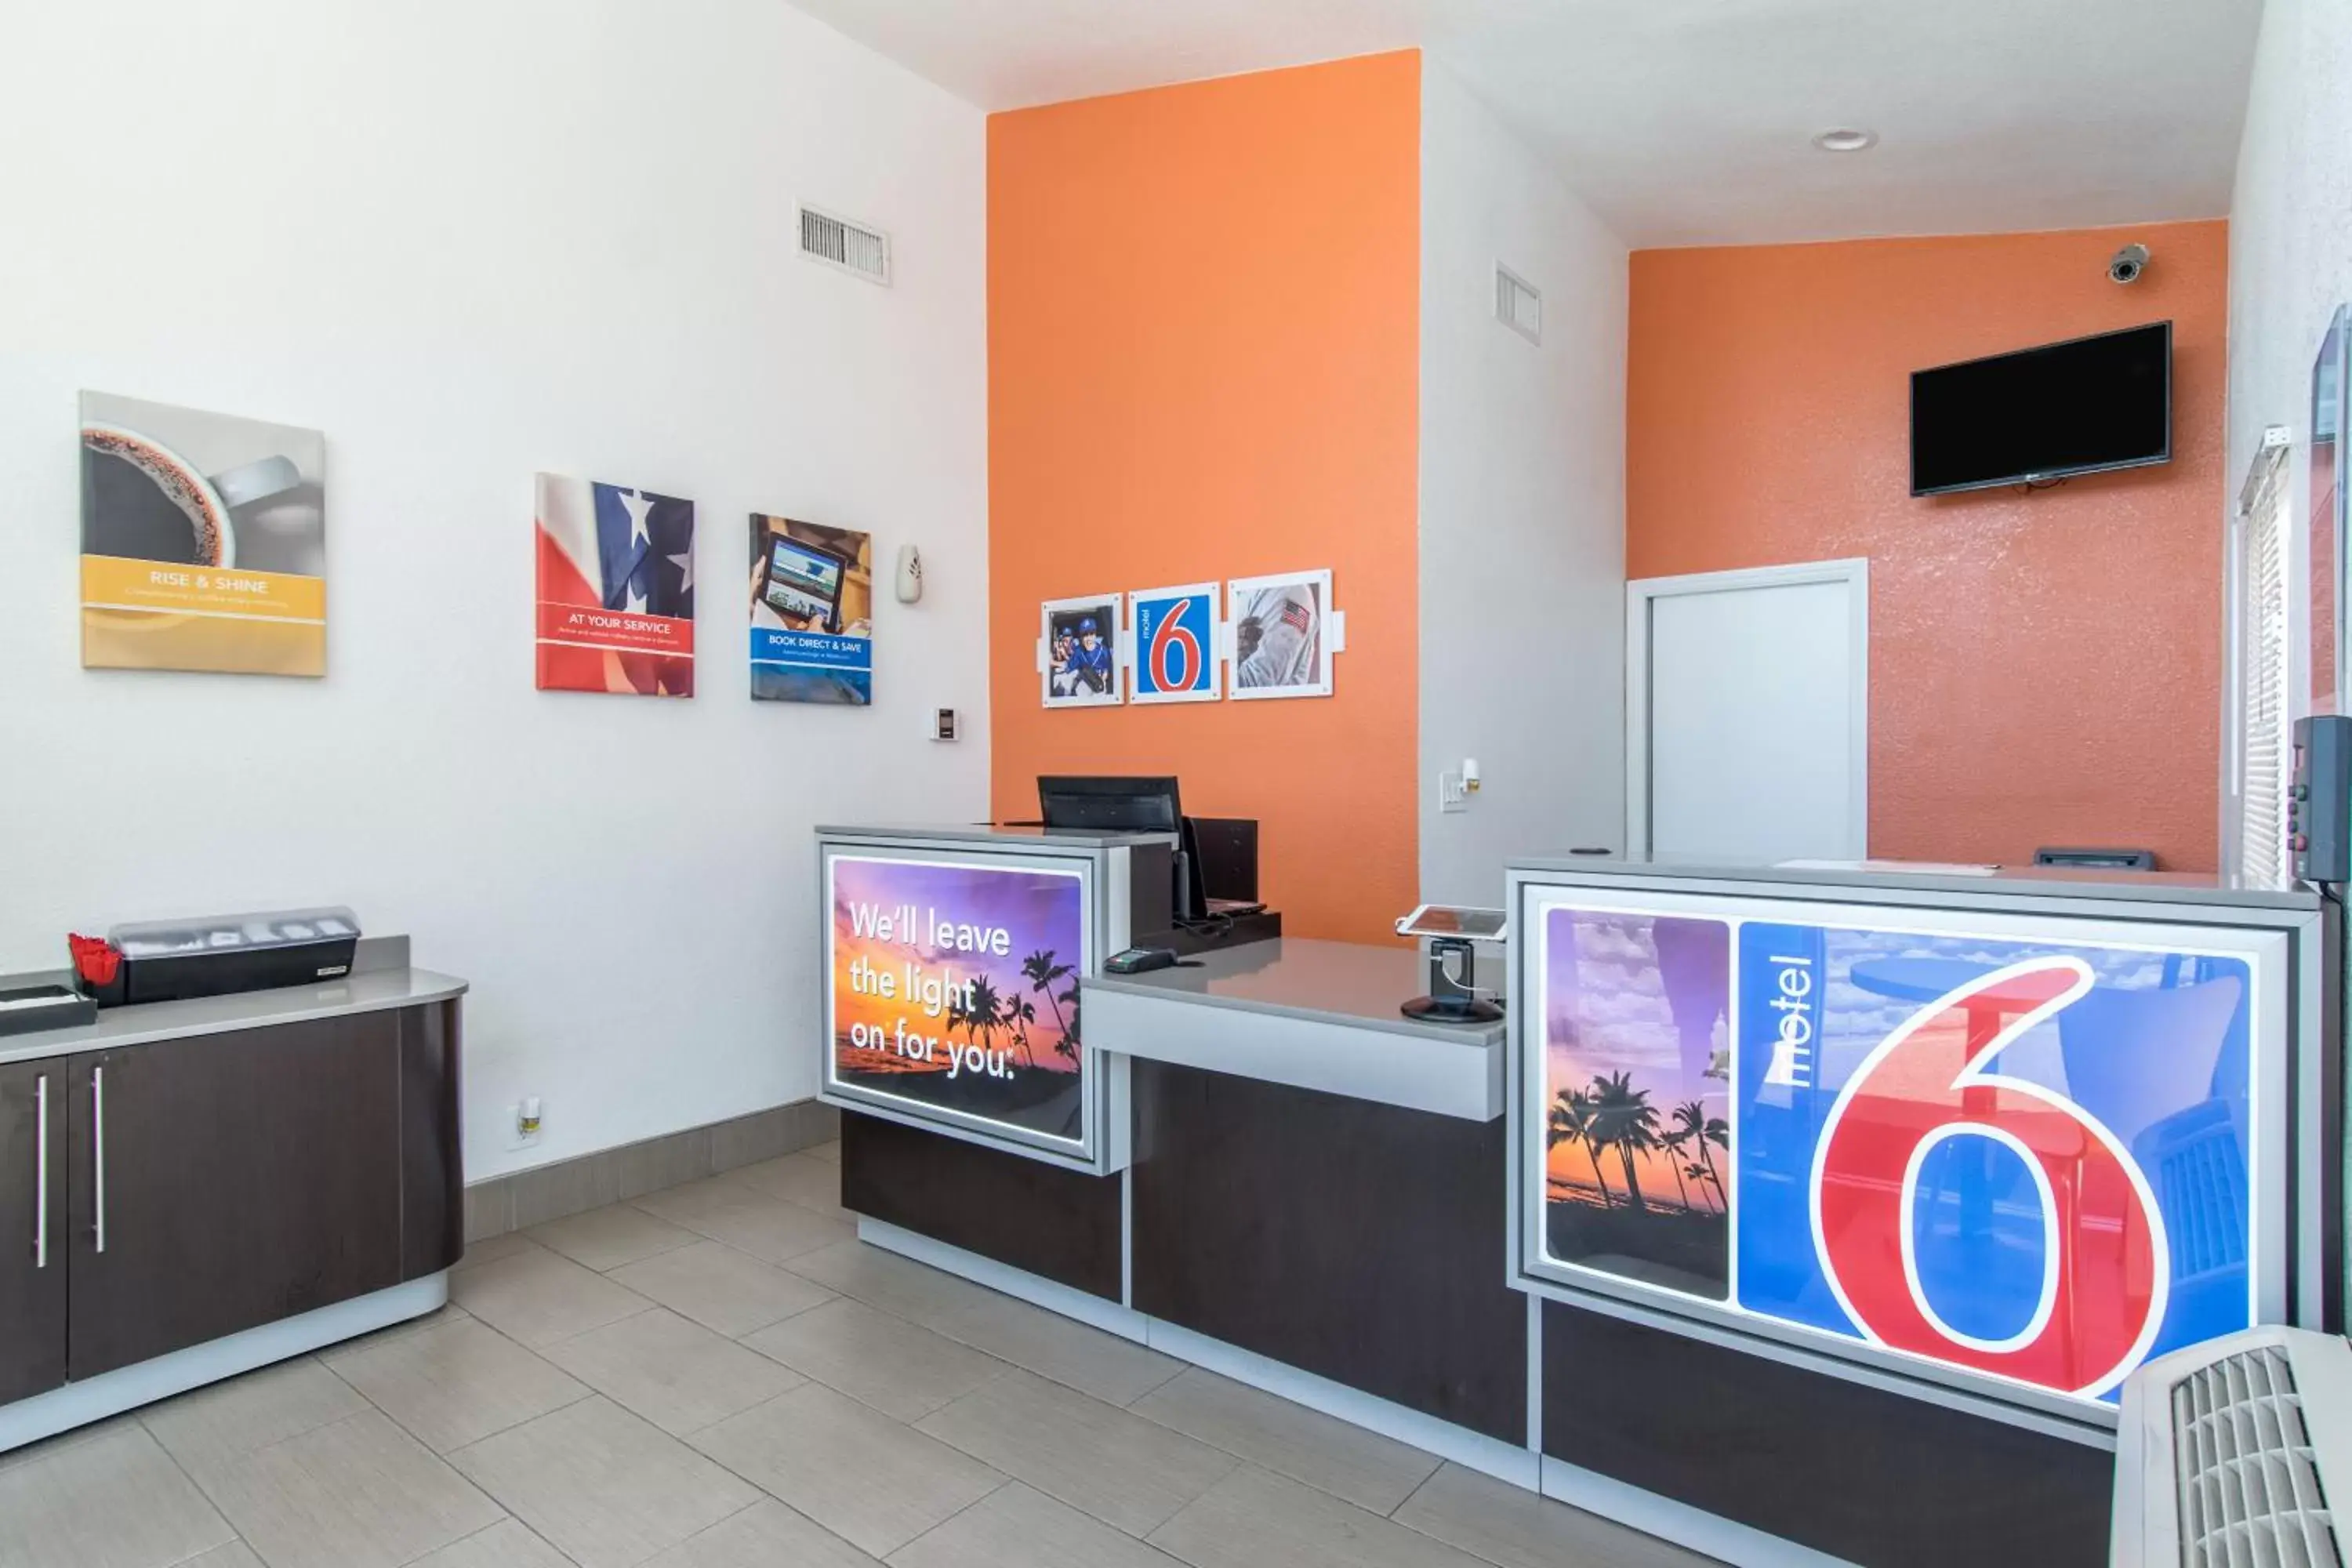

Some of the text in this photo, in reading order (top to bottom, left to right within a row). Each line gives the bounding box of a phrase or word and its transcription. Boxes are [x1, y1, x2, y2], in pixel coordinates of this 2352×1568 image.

[150, 571, 269, 594] RISE & SHINE
[569, 614, 672, 634] AT YOUR SERVICE
[769, 634, 862, 653] BOOK DIRECT & SAVE
[1149, 598, 1202, 693] 6
[928, 907, 1011, 956] leave
[849, 956, 976, 1017] the light
[851, 1022, 885, 1051] on
[895, 1018, 938, 1062] for
[1769, 955, 1812, 1088] motel
[1809, 954, 2170, 1399] 6
